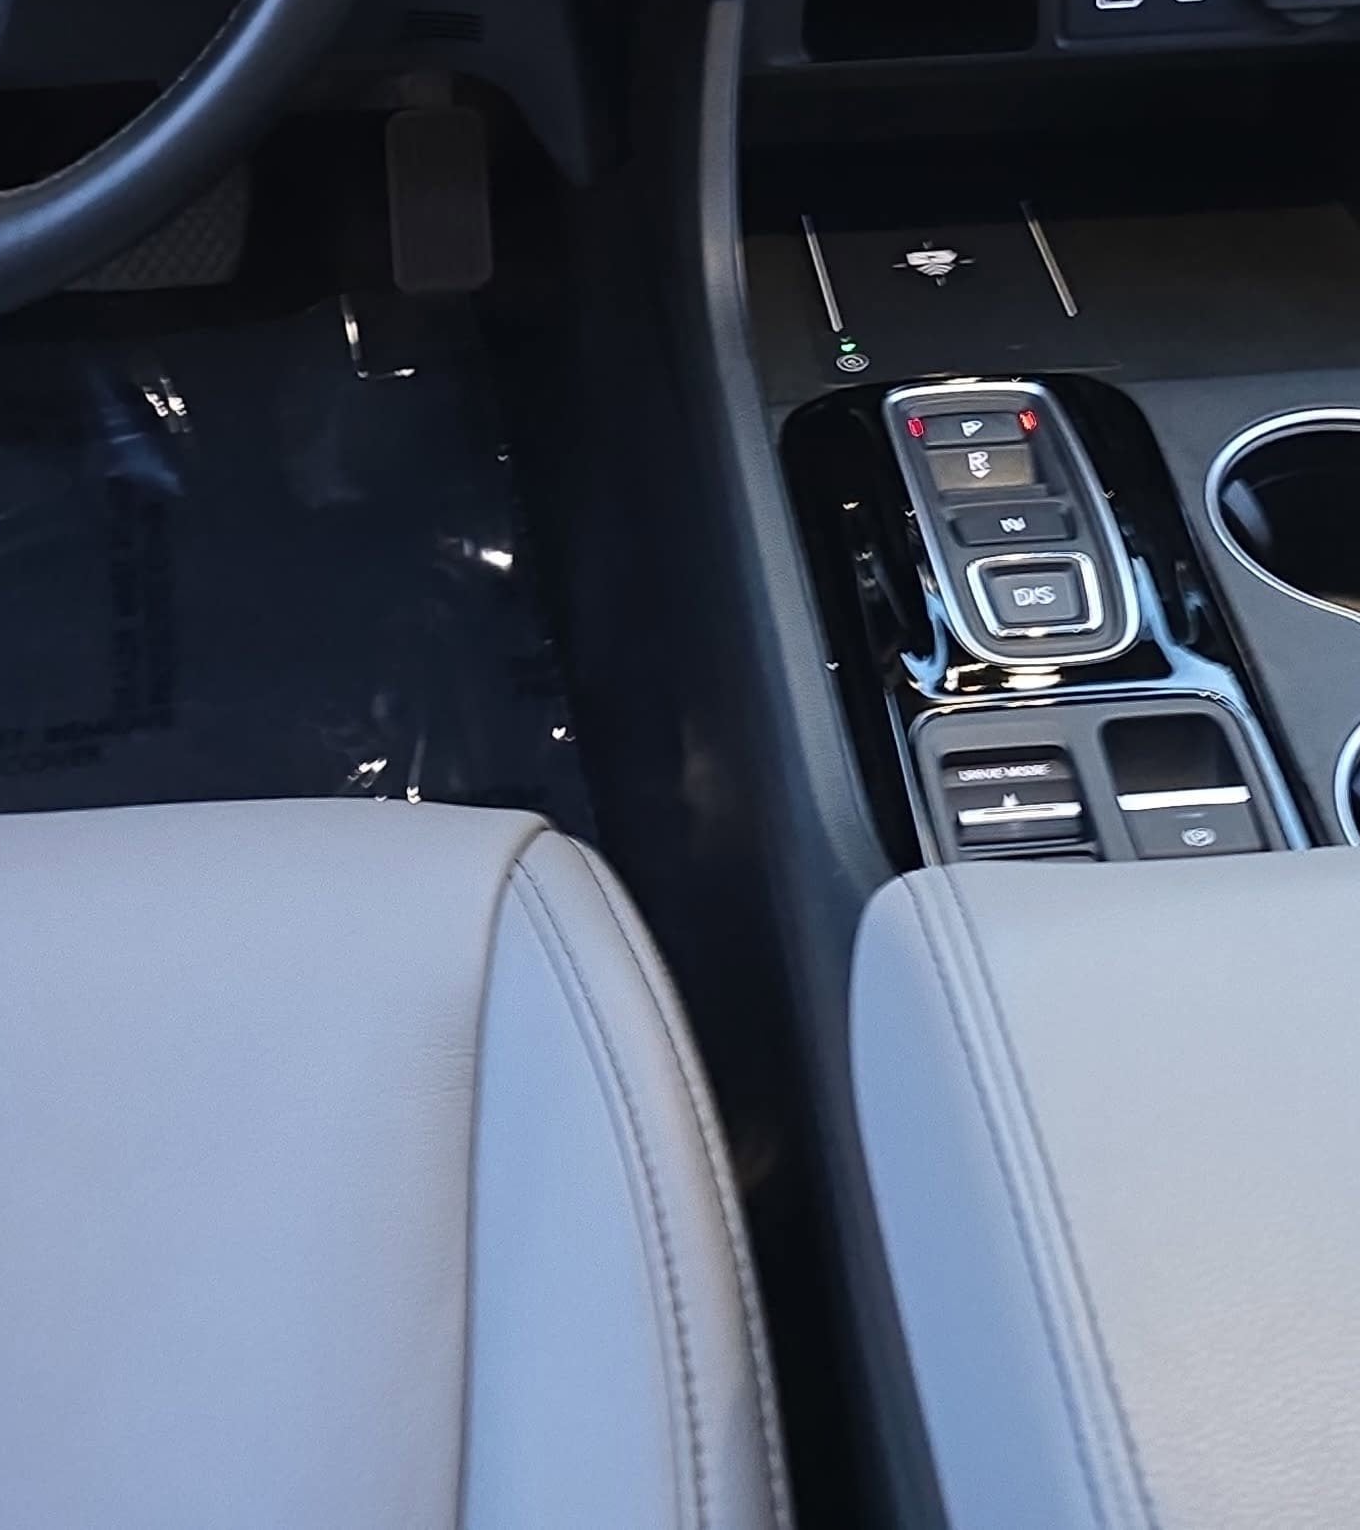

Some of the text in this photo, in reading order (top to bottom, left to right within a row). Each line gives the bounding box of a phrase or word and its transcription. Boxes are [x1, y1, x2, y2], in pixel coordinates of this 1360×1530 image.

[961, 419, 984, 438] P
[967, 451, 990, 471] R
[1000, 516, 1028, 533] N
[958, 763, 1052, 782] DRIVE MODE
